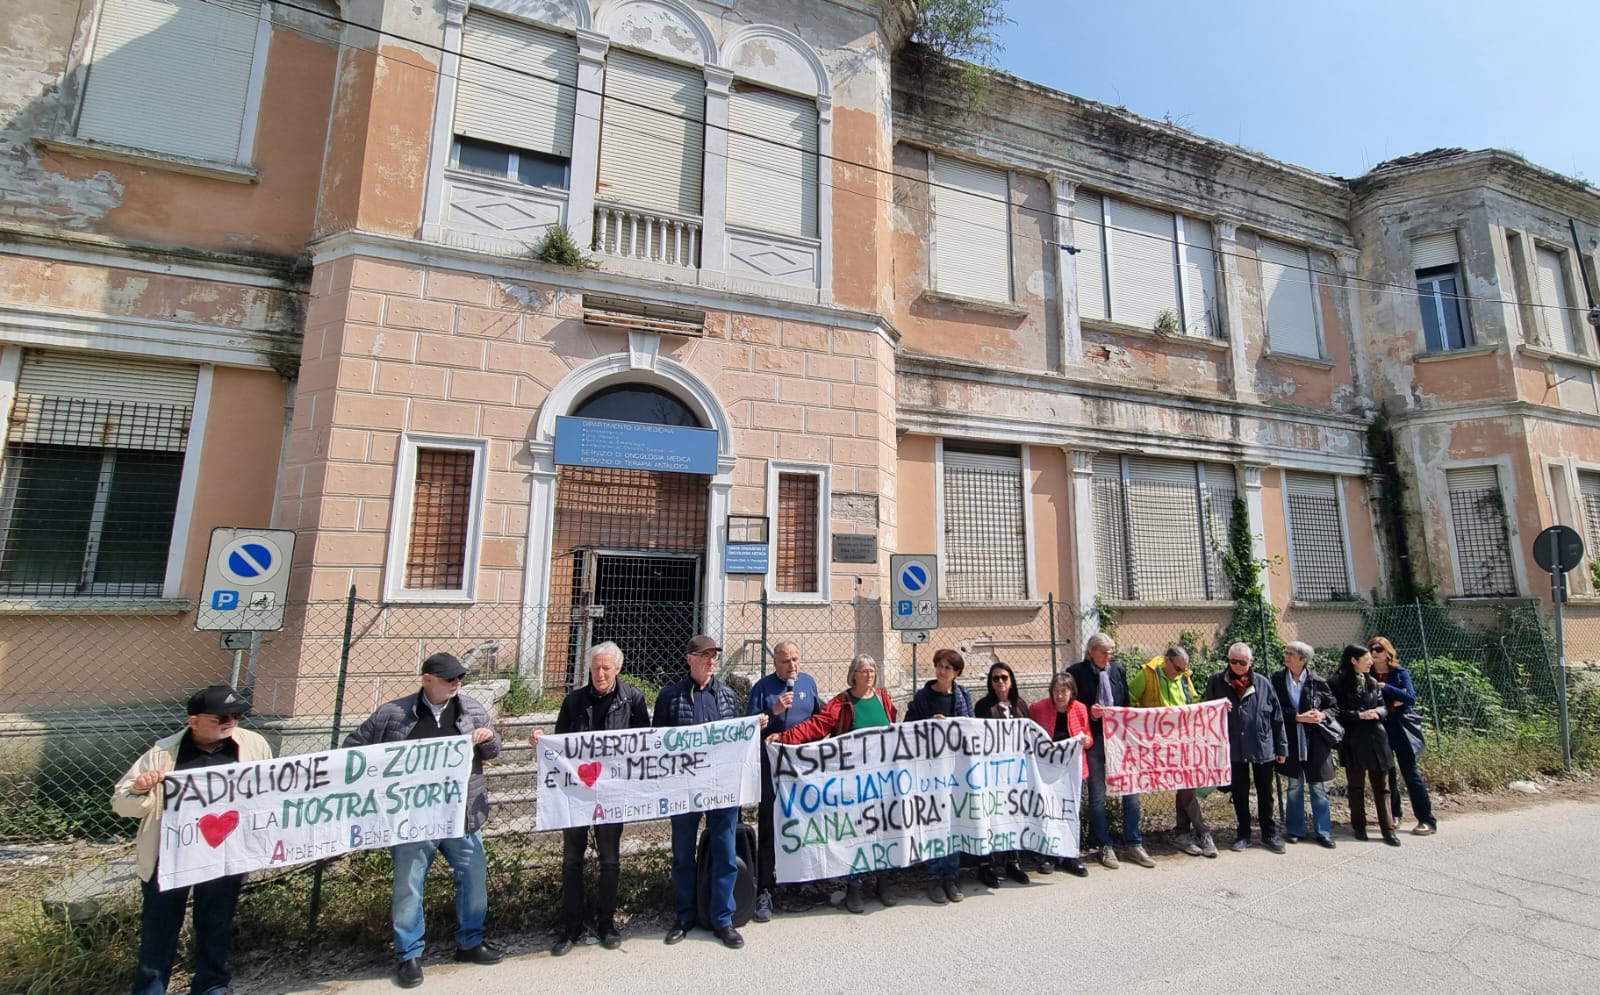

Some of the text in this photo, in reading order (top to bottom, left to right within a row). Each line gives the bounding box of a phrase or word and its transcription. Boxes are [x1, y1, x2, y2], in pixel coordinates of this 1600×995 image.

[219, 593, 234, 608] P
[564, 772, 578, 787] IL
[626, 752, 711, 781] MESTRE
[773, 720, 962, 779] ASPETTANDO
[252, 811, 279, 832] LA
[281, 788, 379, 830] NOSTRA
[774, 768, 914, 818] VOGLIAMO
[920, 773, 959, 793] UNA
[780, 811, 857, 854] SANA
[862, 795, 942, 834] SICURA
[850, 841, 899, 873] ABC
